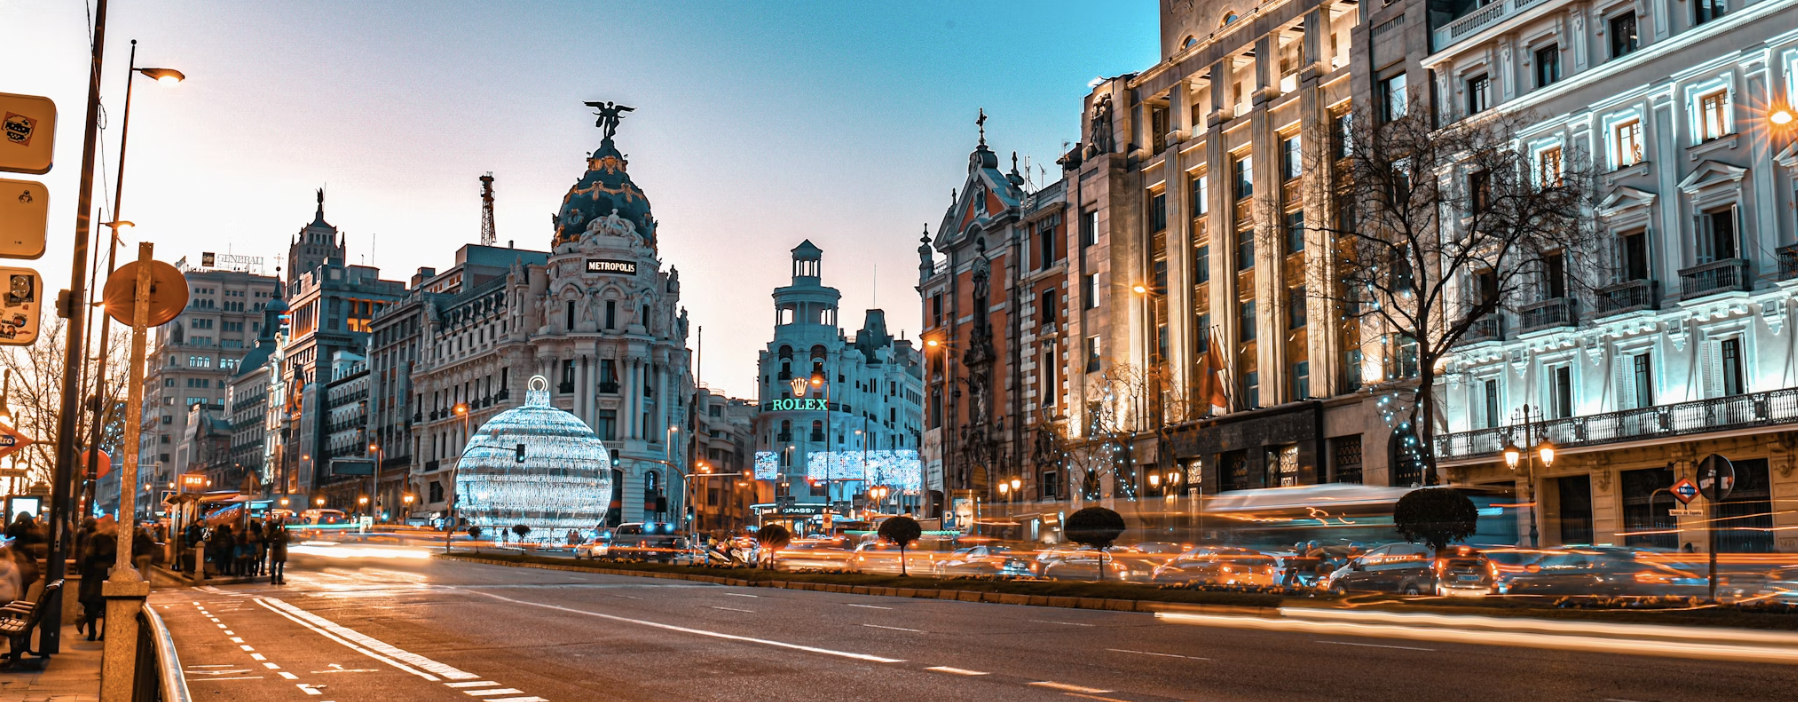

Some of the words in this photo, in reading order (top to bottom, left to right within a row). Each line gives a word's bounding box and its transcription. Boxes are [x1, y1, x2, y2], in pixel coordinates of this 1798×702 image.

[217, 254, 263, 265] GENERALI
[589, 262, 635, 272] METROPOLIS
[773, 398, 828, 410] ROLEX
[944, 511, 953, 523] P
